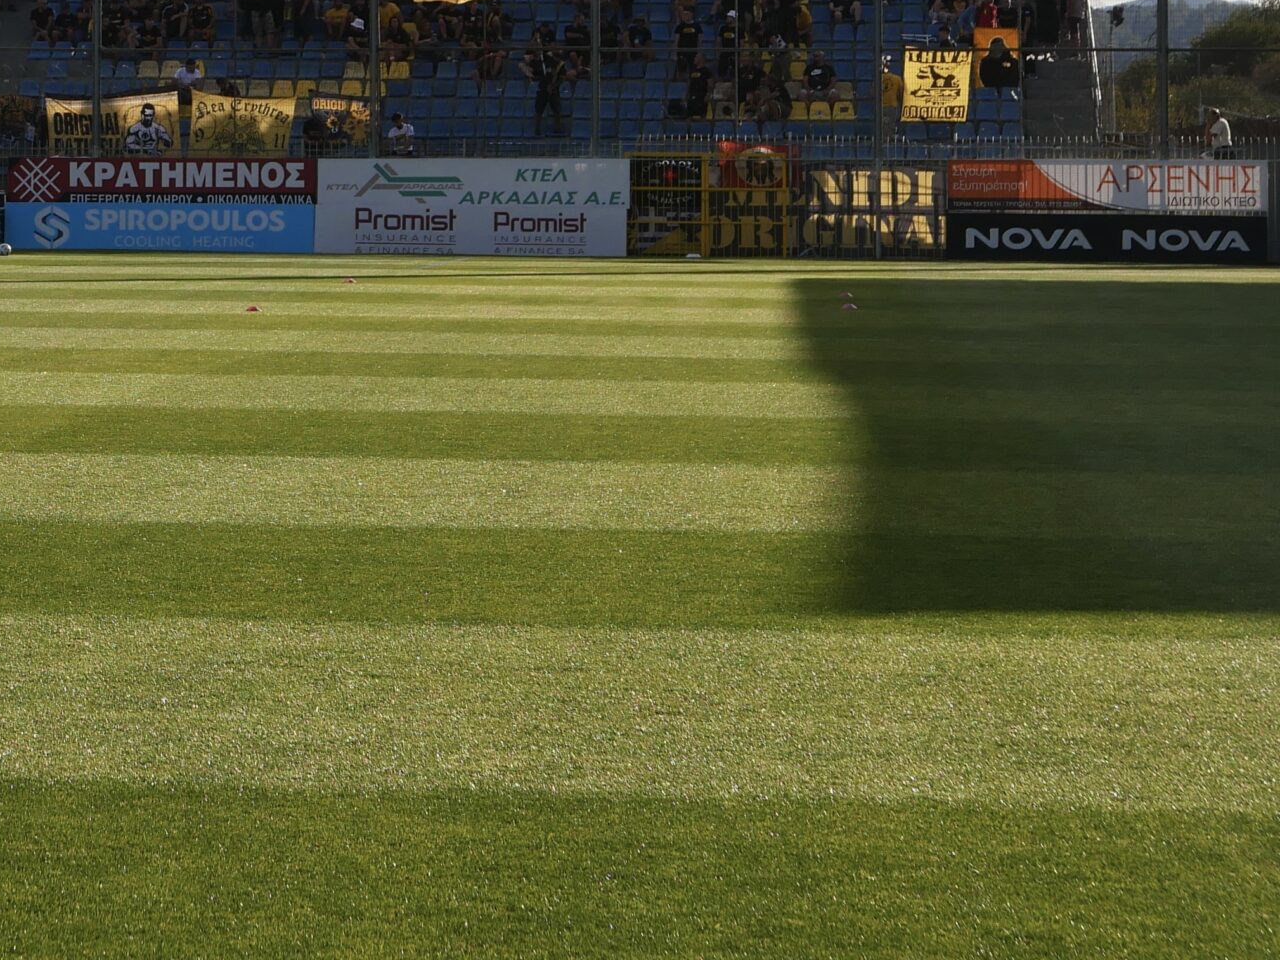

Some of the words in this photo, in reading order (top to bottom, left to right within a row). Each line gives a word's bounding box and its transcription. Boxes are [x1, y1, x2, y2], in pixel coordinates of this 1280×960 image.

[909, 50, 969, 63] THIVA
[904, 106, 952, 118] ORIGINAL
[53, 112, 120, 136] ORIGAL
[68, 161, 306, 189] ΚΡΑΤΗΜΕΝΟΣ
[514, 168, 568, 183] ΚΤΕΛ
[1096, 164, 1257, 194] ΑΡΣΕΝΗΣ
[458, 190, 579, 205] ΑΡΚΑΔΙΑΣ
[583, 192, 627, 206] Α.Ε.
[1167, 195, 1220, 207] ΙΔΙΩΤΙΚΟ
[1224, 196, 1257, 207] ΚΤΕΟ
[84, 209, 286, 232] SPIROPOULOS
[354, 208, 457, 231] Promist
[493, 211, 587, 233] Promist
[114, 235, 182, 249] COOLING
[192, 235, 255, 249] HEATING
[355, 233, 457, 242] INSURANCE
[494, 235, 587, 244] INSURANCE
[965, 226, 1093, 250] NOVA
[1122, 229, 1251, 252] NOVA
[368, 246, 430, 254] FINANCE
[506, 247, 563, 255] FINANCE
